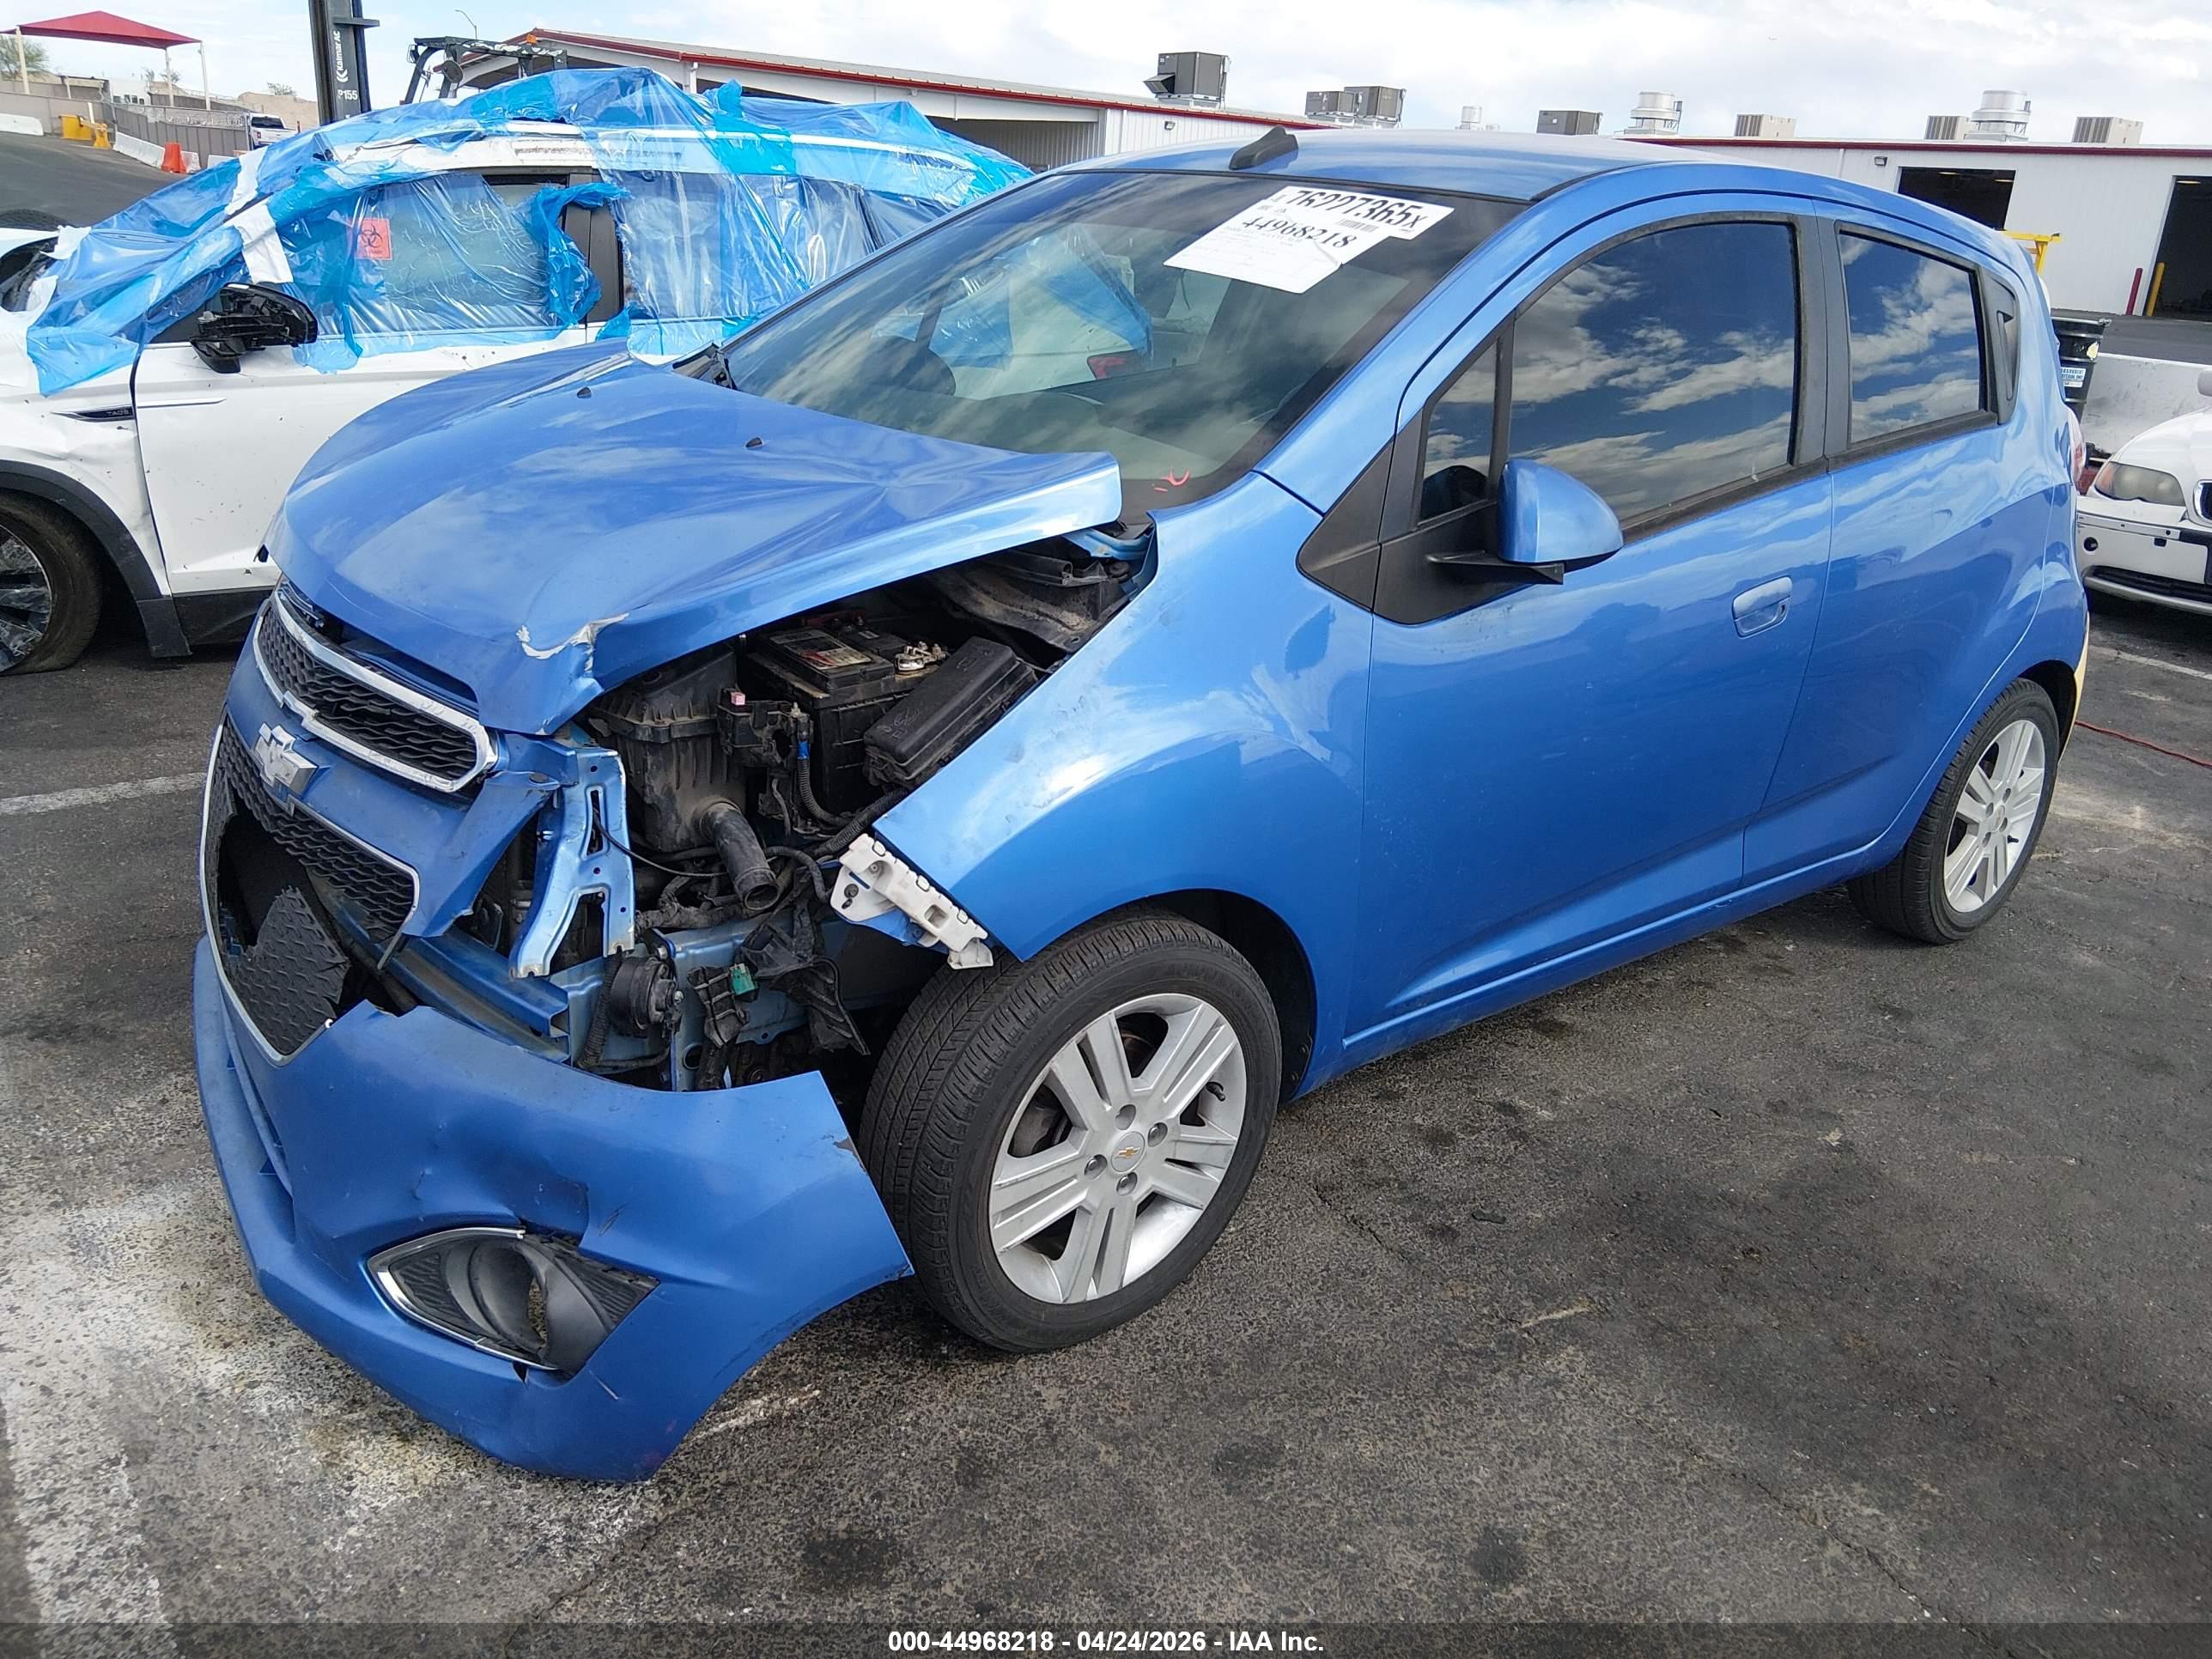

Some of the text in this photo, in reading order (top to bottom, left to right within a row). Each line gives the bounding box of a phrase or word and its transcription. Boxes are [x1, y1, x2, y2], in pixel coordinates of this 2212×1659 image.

[333, 30, 344, 70] Kalmar AC
[1242, 216, 1358, 248] 44968218
